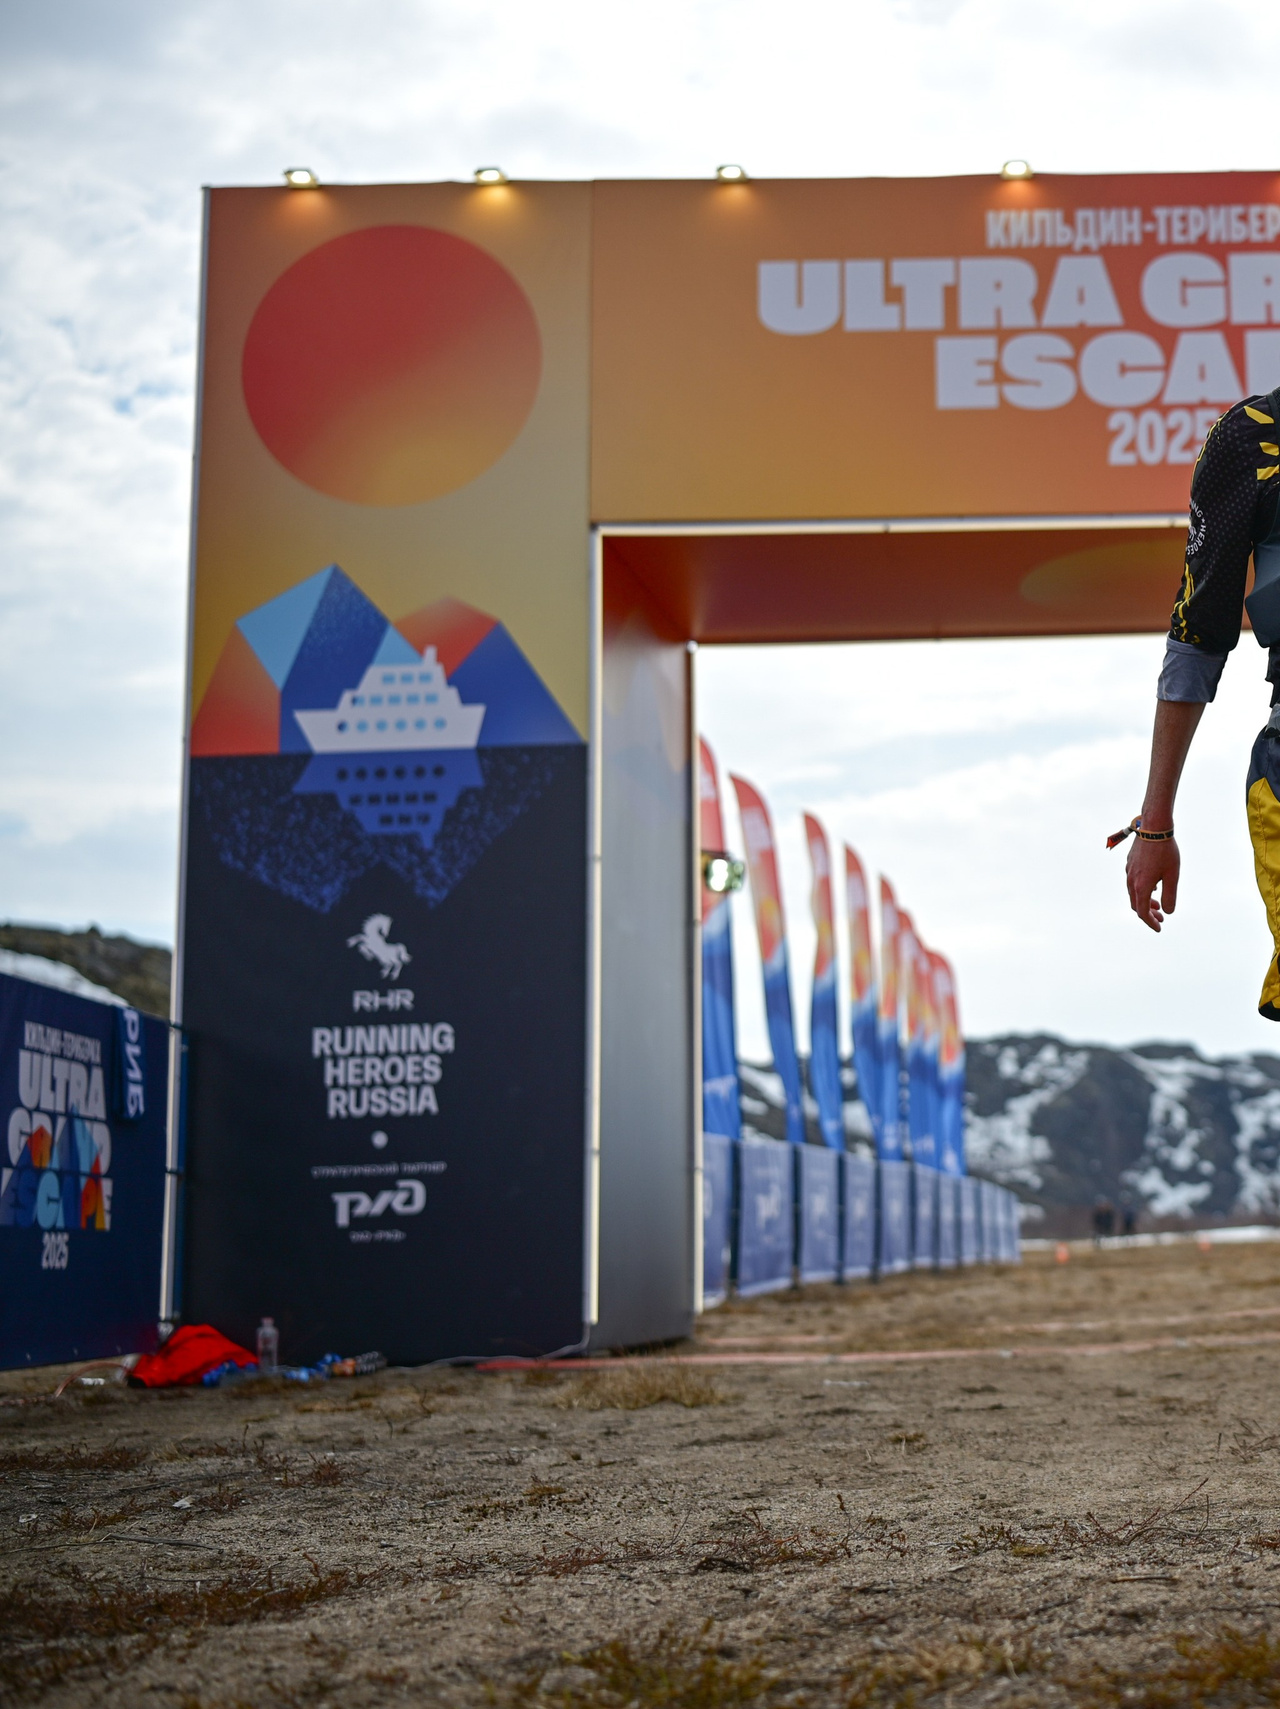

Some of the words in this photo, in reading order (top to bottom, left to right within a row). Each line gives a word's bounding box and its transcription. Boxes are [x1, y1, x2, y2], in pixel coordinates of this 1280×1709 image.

[757, 255, 1125, 336] ULTRA
[353, 989, 415, 1012] RHR
[312, 1022, 455, 1058] RUNNING
[19, 1049, 107, 1121] ULTRA
[324, 1054, 443, 1088] HEROES
[327, 1085, 439, 1119] RUSSIA
[42, 1231, 69, 1270] 2025
